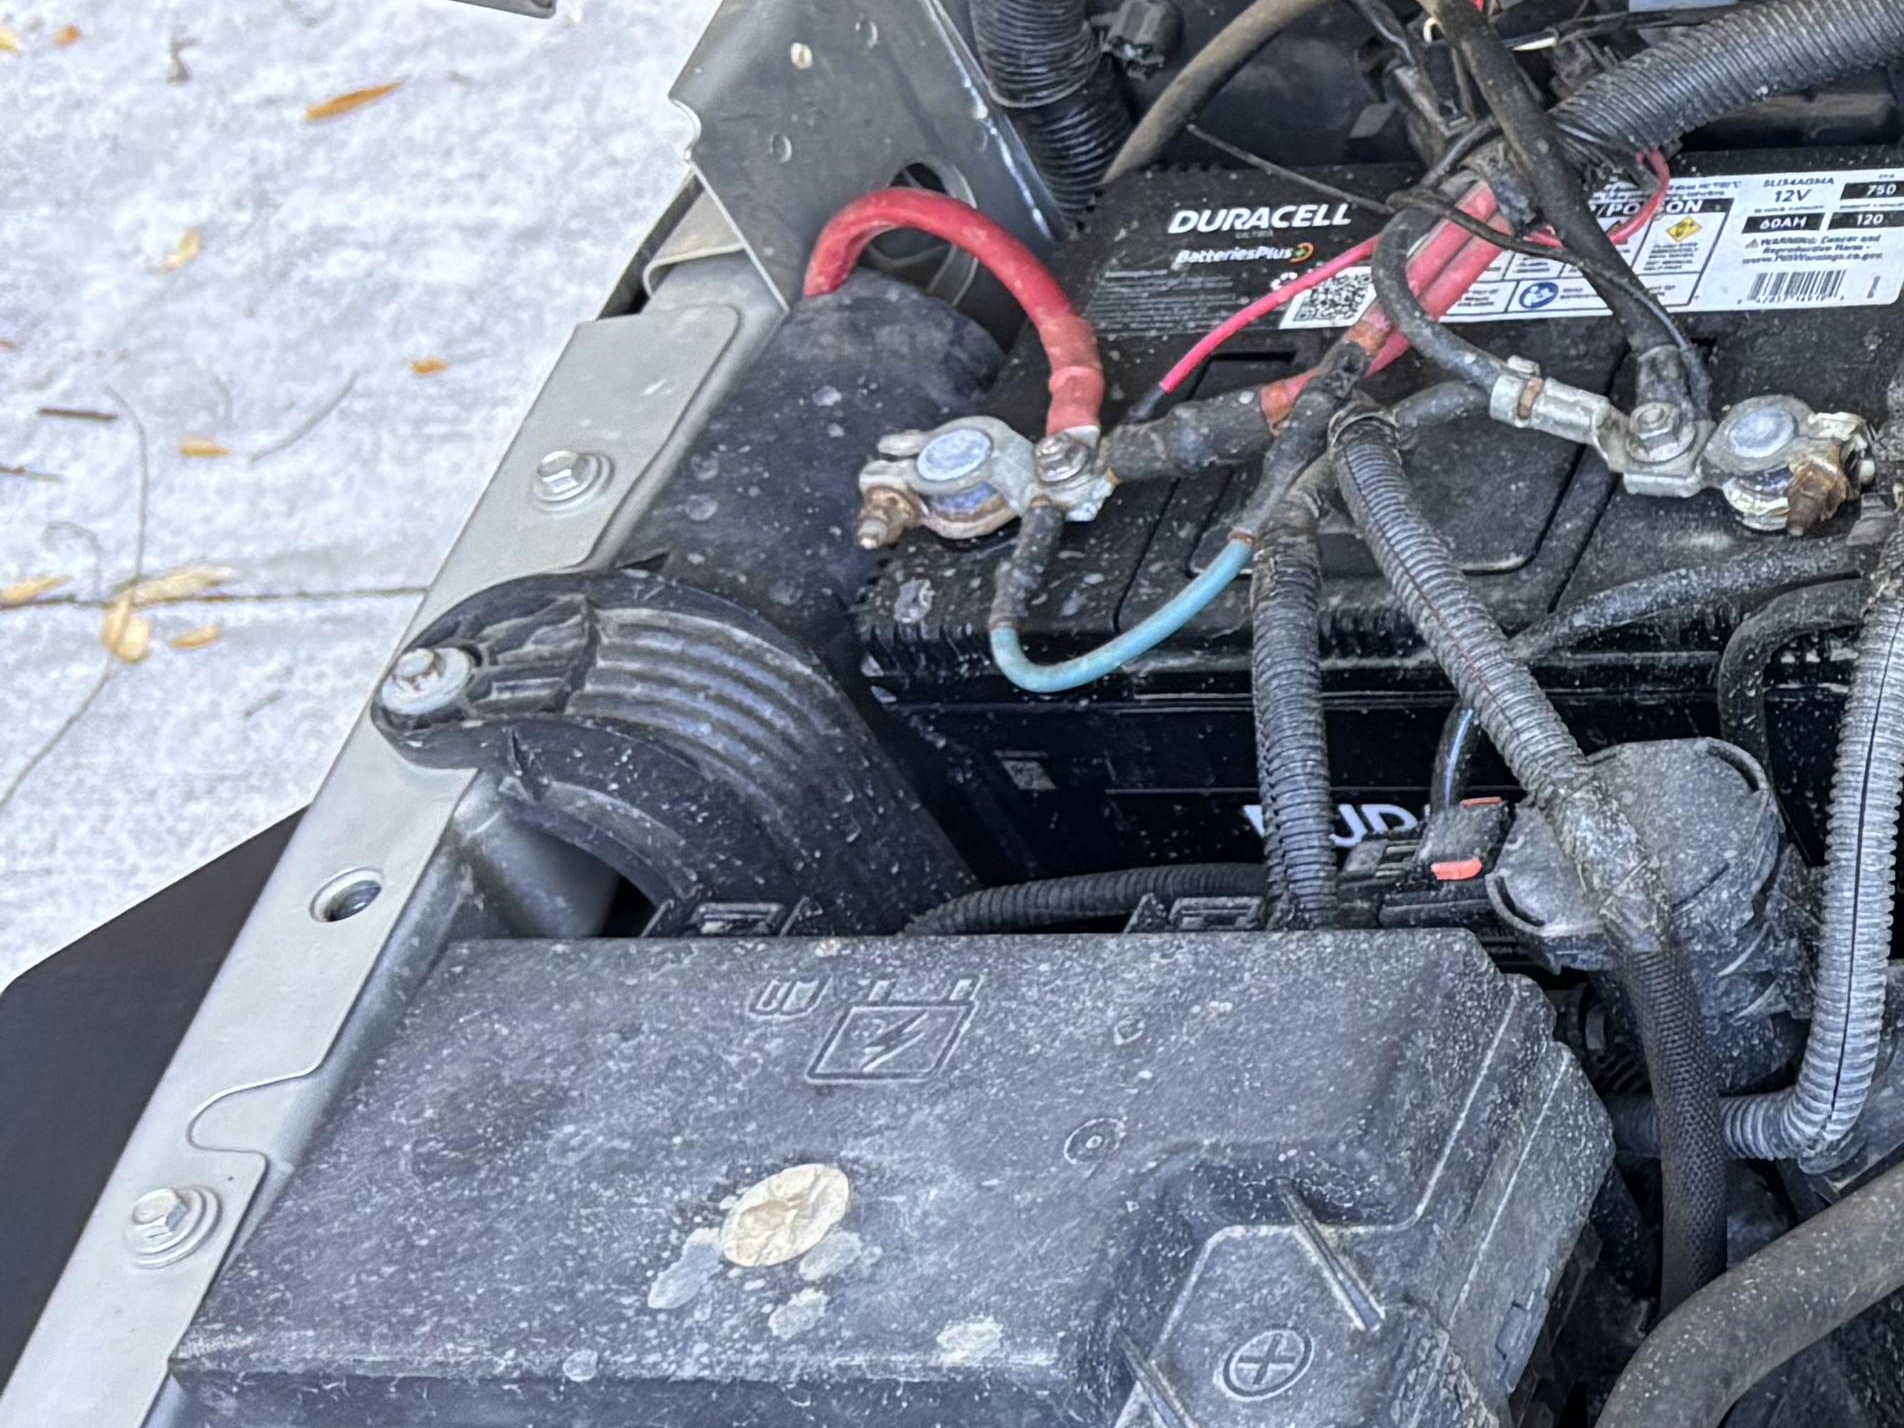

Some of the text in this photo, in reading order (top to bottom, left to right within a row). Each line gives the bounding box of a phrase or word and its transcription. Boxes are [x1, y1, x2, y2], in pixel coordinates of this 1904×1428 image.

[1773, 188, 1813, 203] 12V
[1866, 183, 1897, 196] 750
[1167, 203, 1352, 234] DURACELL
[1759, 216, 1807, 230] 60AH
[1856, 213, 1884, 226] 120
